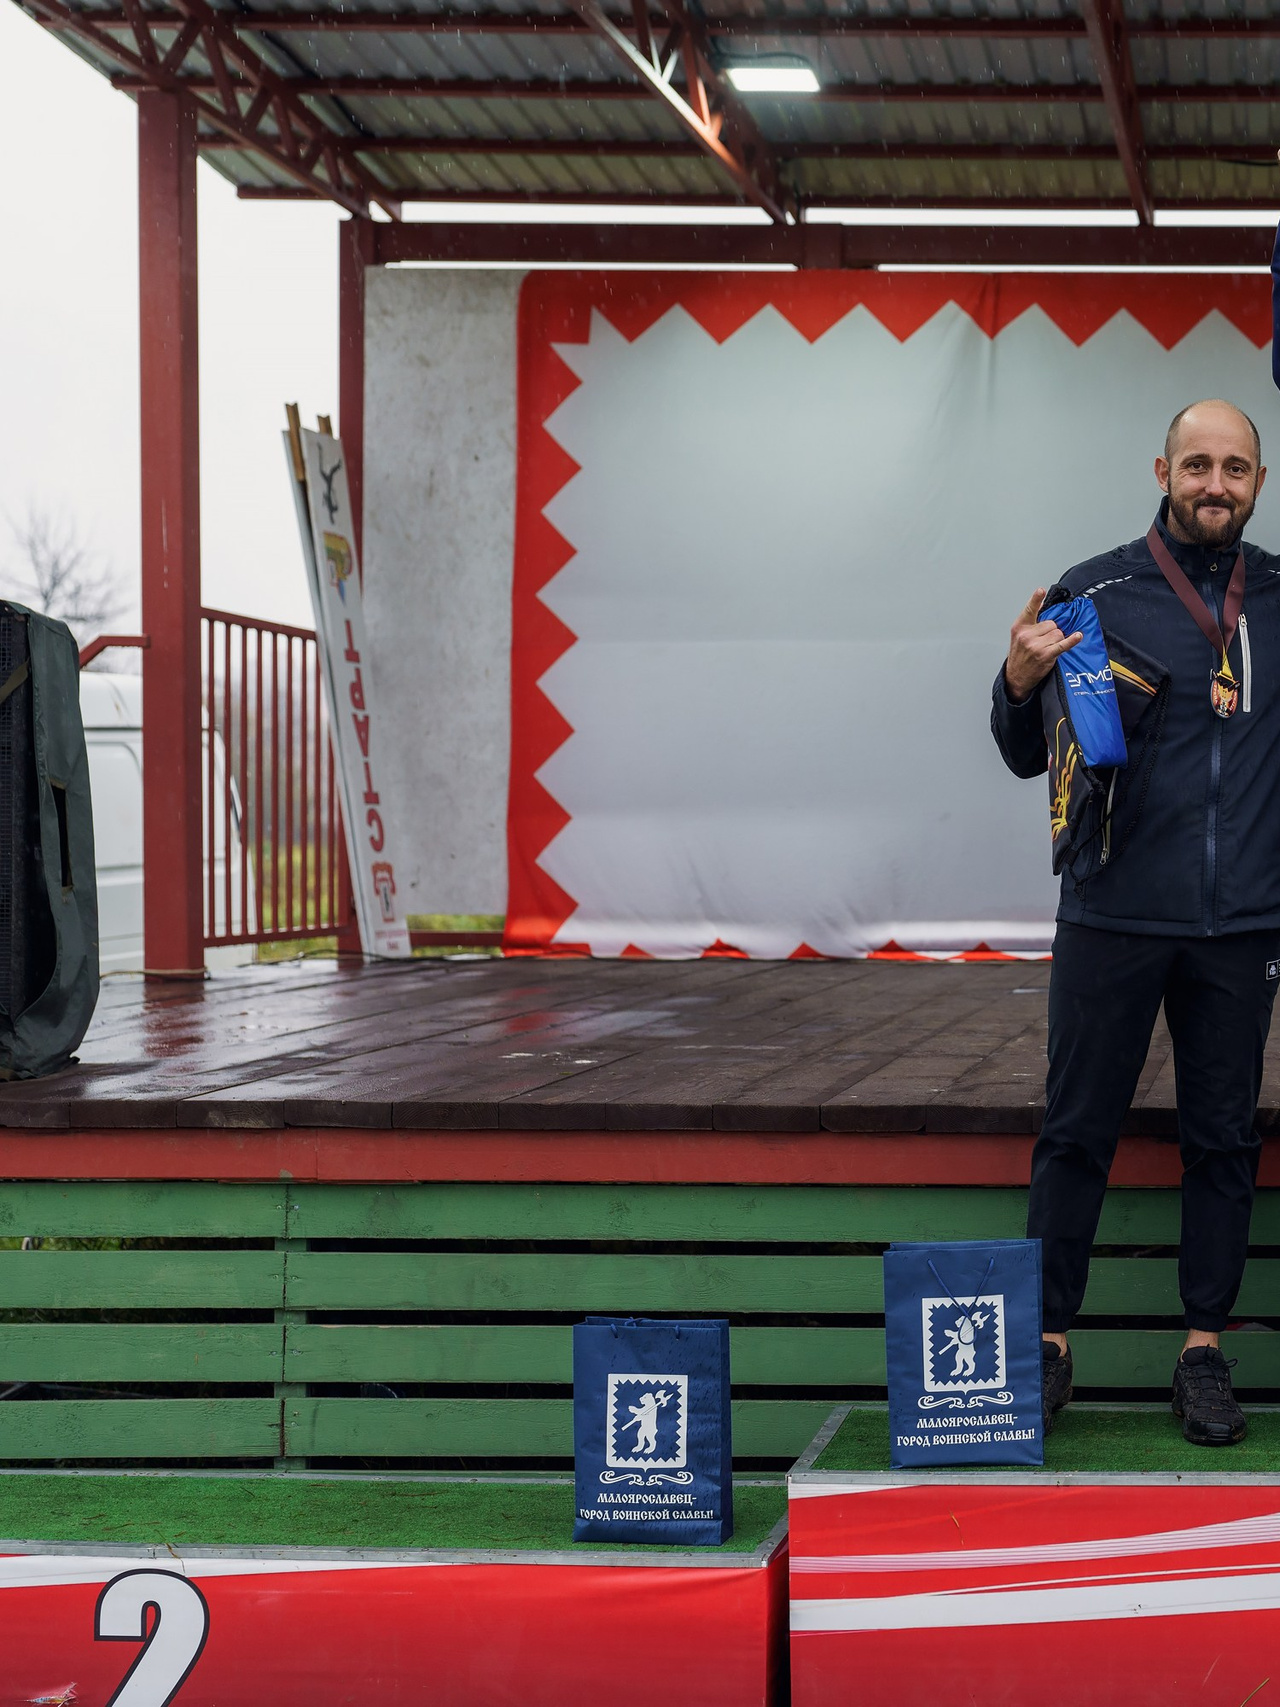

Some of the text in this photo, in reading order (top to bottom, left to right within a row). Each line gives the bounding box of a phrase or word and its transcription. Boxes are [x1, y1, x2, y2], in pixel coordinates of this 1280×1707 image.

[917, 1413, 1018, 1429] МАЛОЯРОСЛАВЕЦ-
[896, 1428, 1036, 1448] ГОРОД ВОИНСКОЙ СЛАВЫ!
[597, 1493, 698, 1507] МАЛОЯРОСЛАВЕЦ-
[580, 1508, 714, 1522] ГОРОД ВОИНСКОЙ СЛАВЫ!
[94, 1568, 211, 1707] 2
